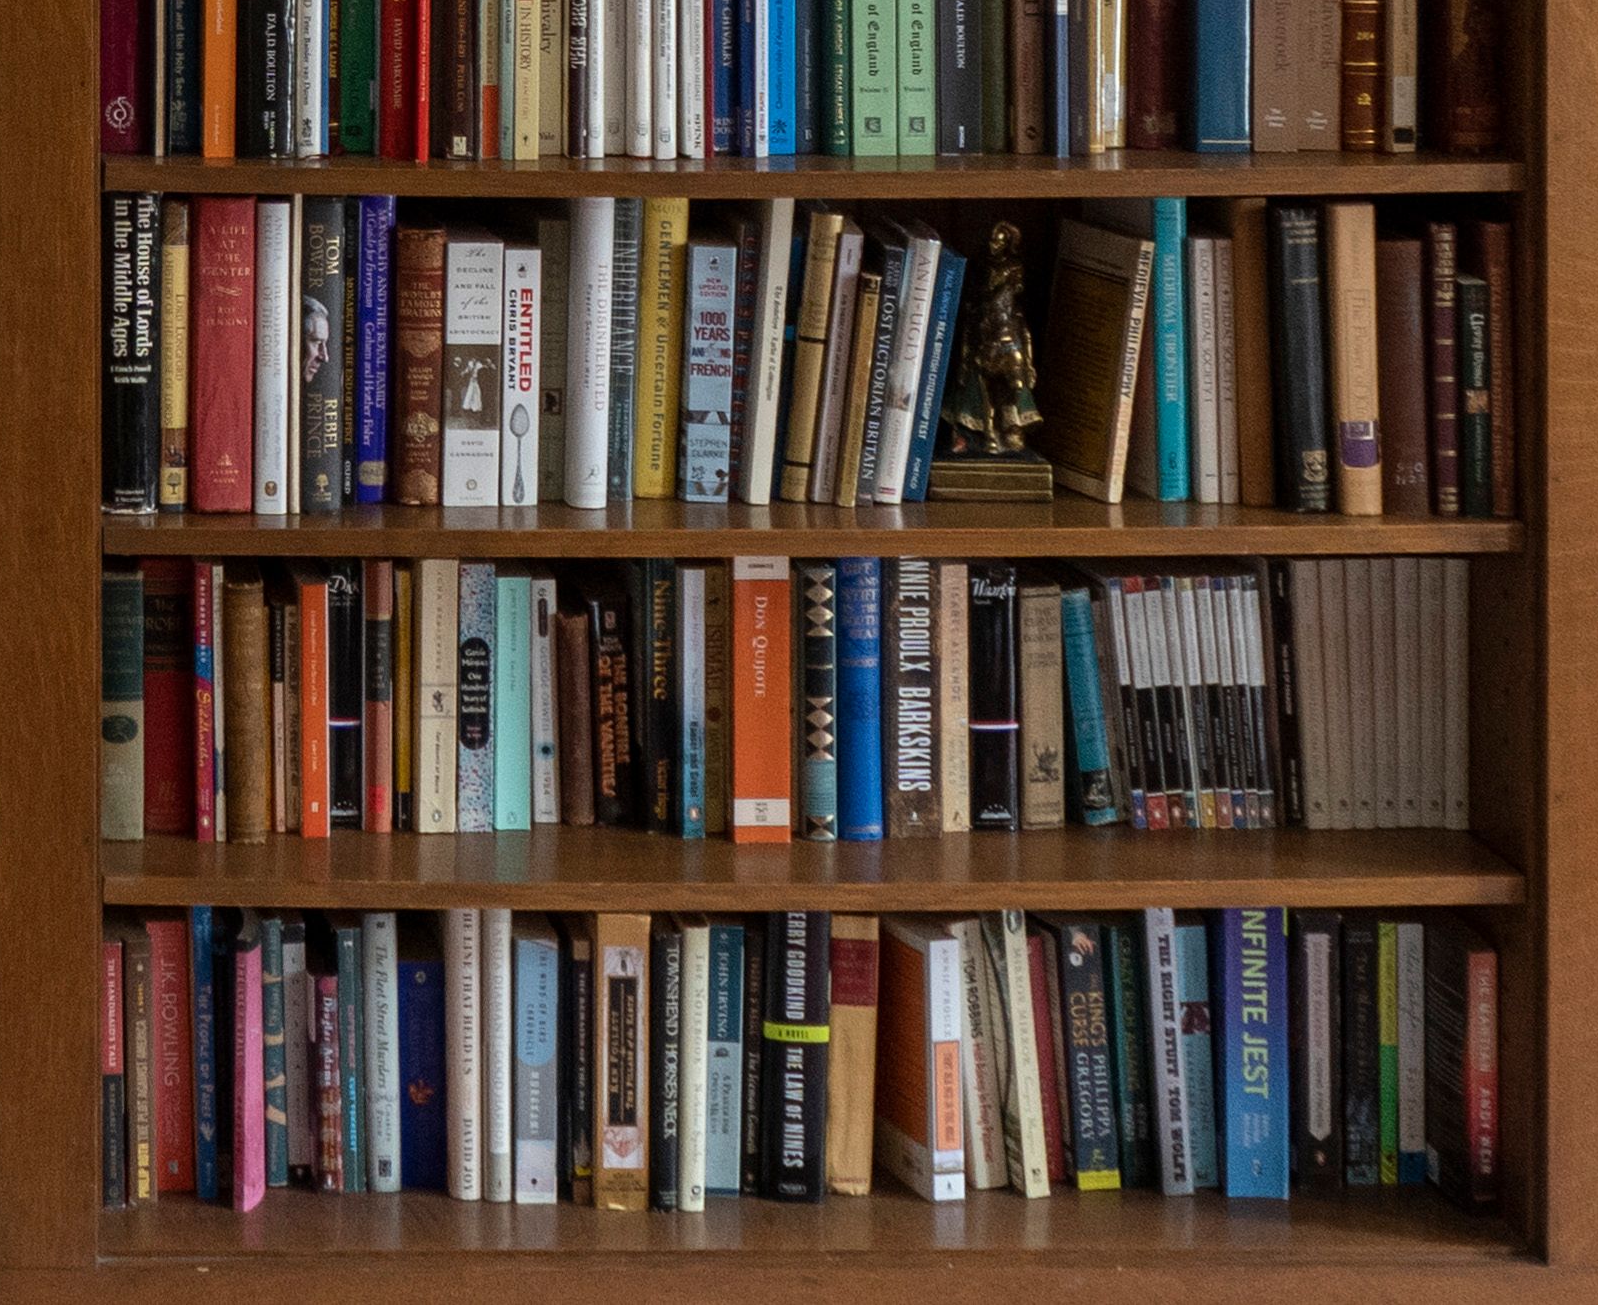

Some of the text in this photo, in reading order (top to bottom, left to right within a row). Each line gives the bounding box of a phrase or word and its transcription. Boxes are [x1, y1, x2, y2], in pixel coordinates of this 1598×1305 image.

[111, 199, 132, 355] in the Middle Ages
[136, 196, 155, 357] The House of Lords
[326, 236, 340, 275] TOM
[506, 290, 516, 393] CHRIS BRYANT
[519, 289, 533, 393] ENTITLED
[324, 399, 338, 453] REBEL
[898, 607, 930, 671] PROULX
[898, 686, 930, 790] BARKSKINS
[1243, 911, 1268, 1098] NFINITE JEST
